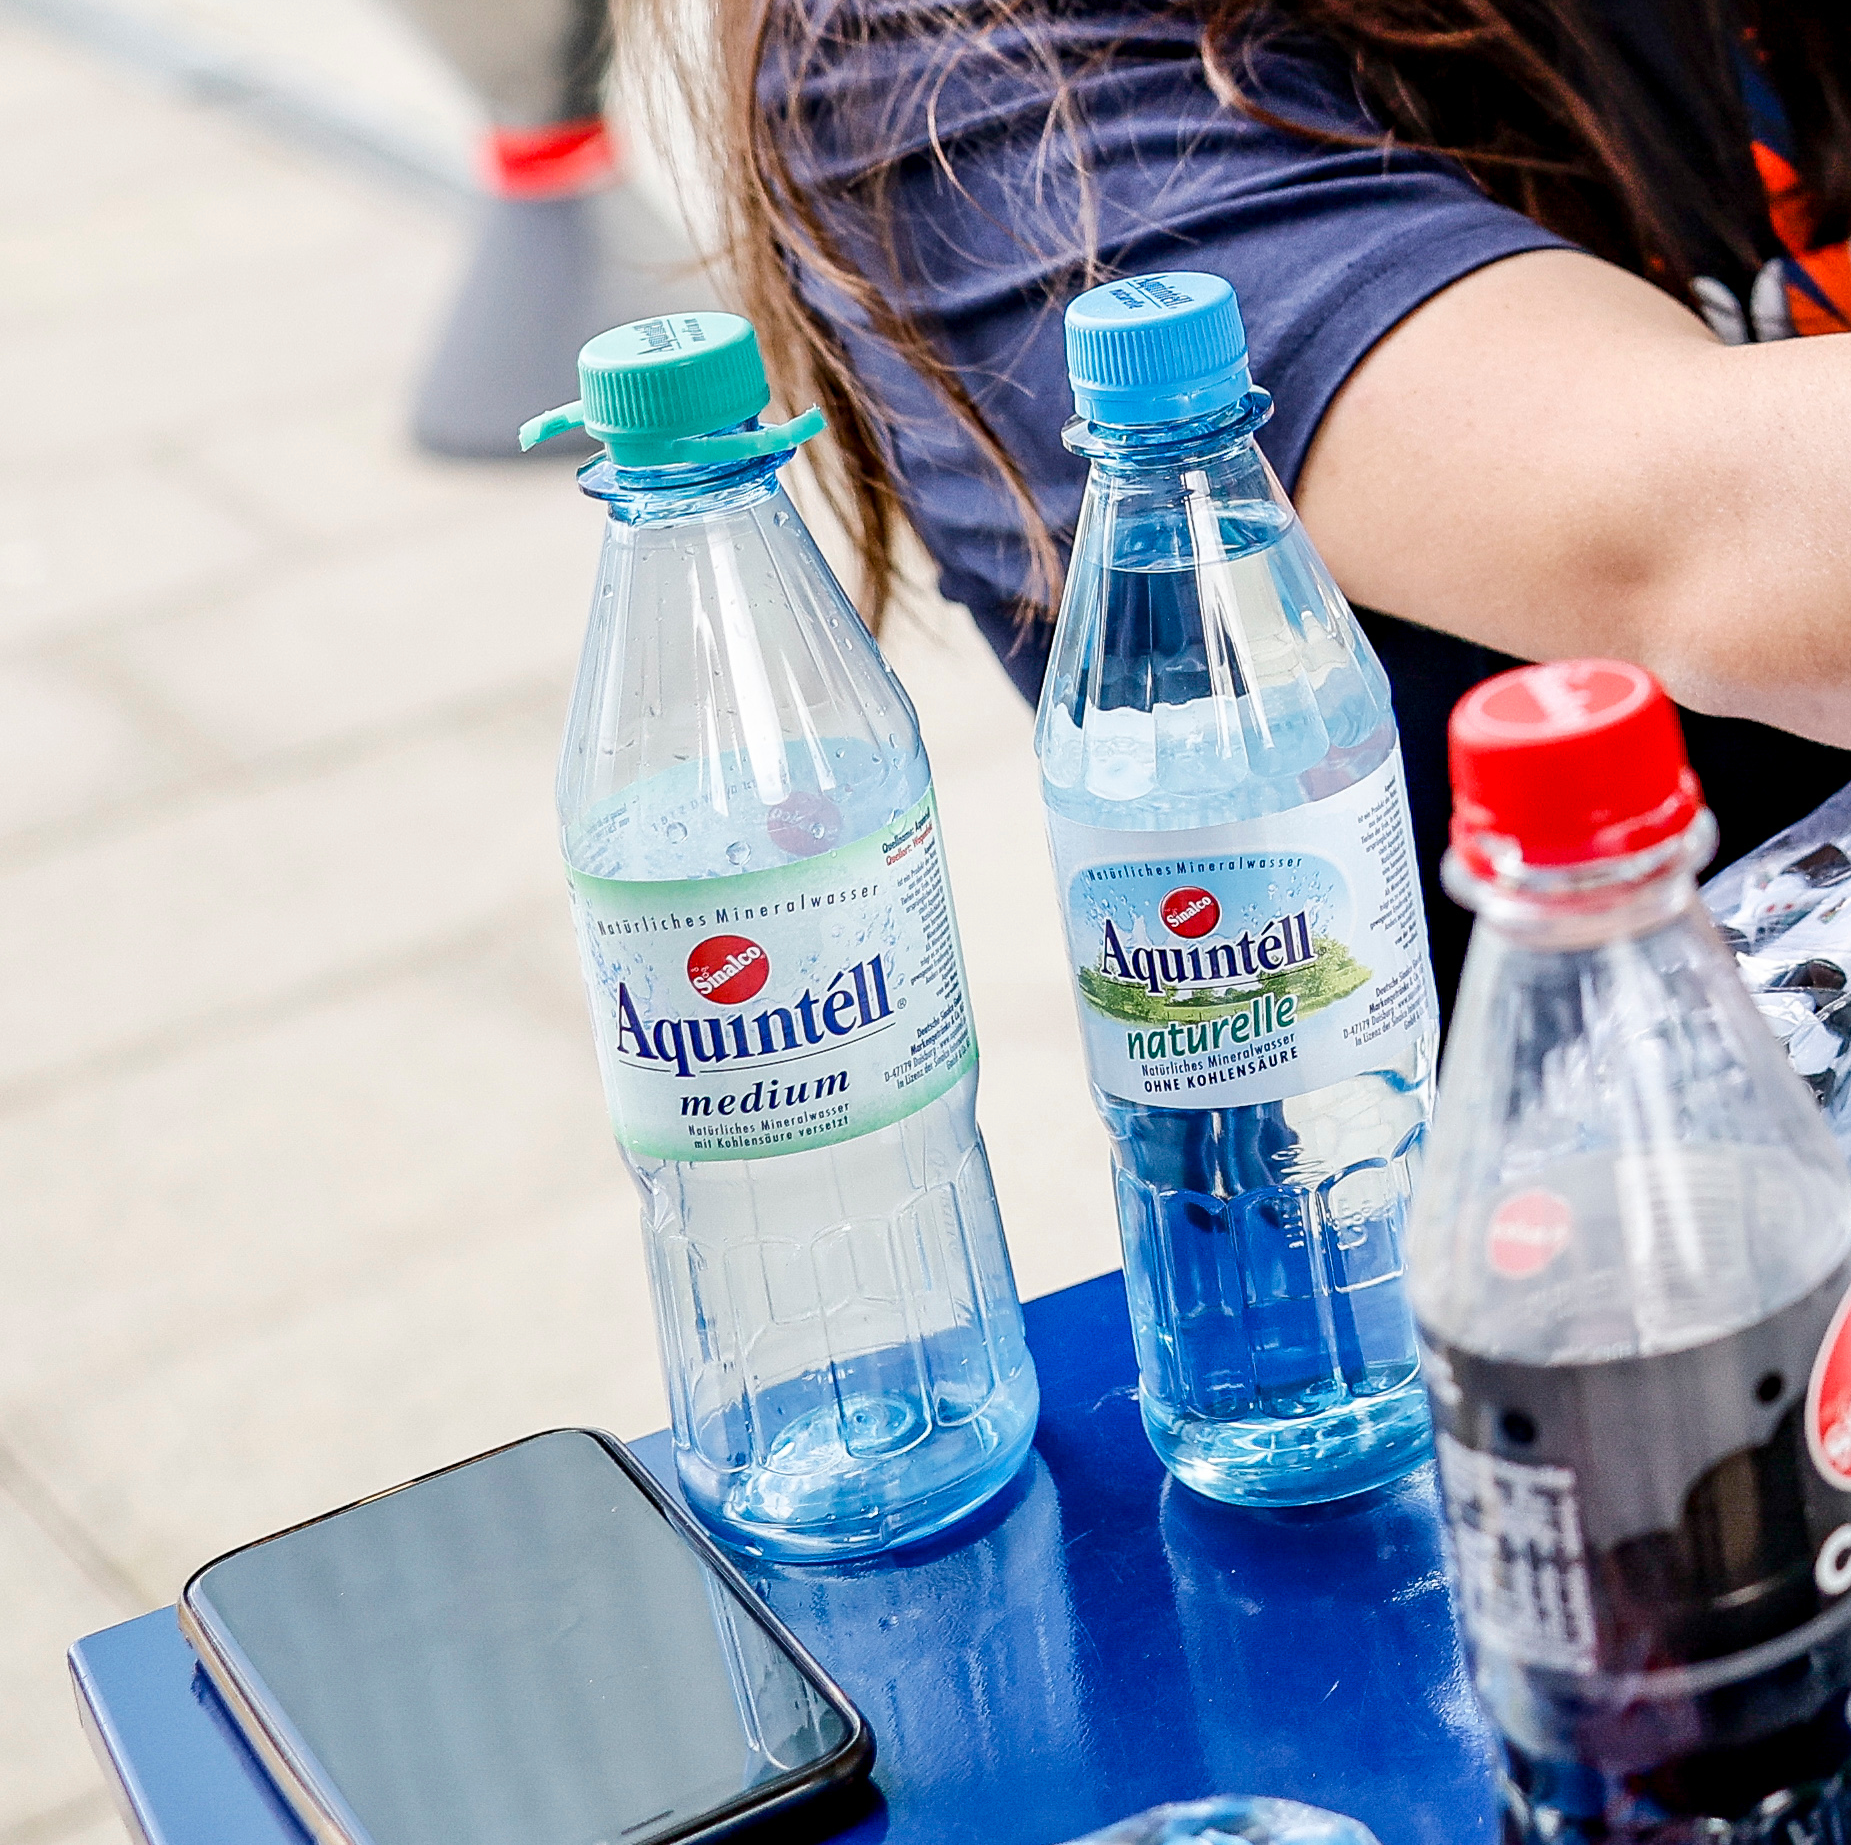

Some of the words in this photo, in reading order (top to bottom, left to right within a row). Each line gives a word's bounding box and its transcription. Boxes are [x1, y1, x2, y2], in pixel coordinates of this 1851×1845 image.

[1088, 865, 1171, 881] Natürliches
[1177, 857, 1302, 874] Mineralwasser
[598, 913, 706, 936] Natürliches
[716, 884, 878, 923] Mineralwasser
[1166, 896, 1212, 928] Sinalco
[693, 946, 761, 995] Sinalco
[1101, 911, 1315, 994] Aquintéll
[617, 953, 894, 1077] Aquintéll
[1127, 994, 1296, 1059] naturelle
[1142, 1059, 1203, 1076] Natürliches
[1208, 1033, 1295, 1068] Mineralwasser
[1144, 1078, 1181, 1093] OHNE
[1187, 1046, 1298, 1089] KOHLENSÄURE
[681, 1070, 850, 1117] medium
[688, 1119, 755, 1136] Natürliches
[762, 1102, 850, 1130] Mineralwasser
[694, 1138, 712, 1149] mit
[718, 1131, 792, 1147] Kohlensäure
[798, 1115, 849, 1137] versetzt
